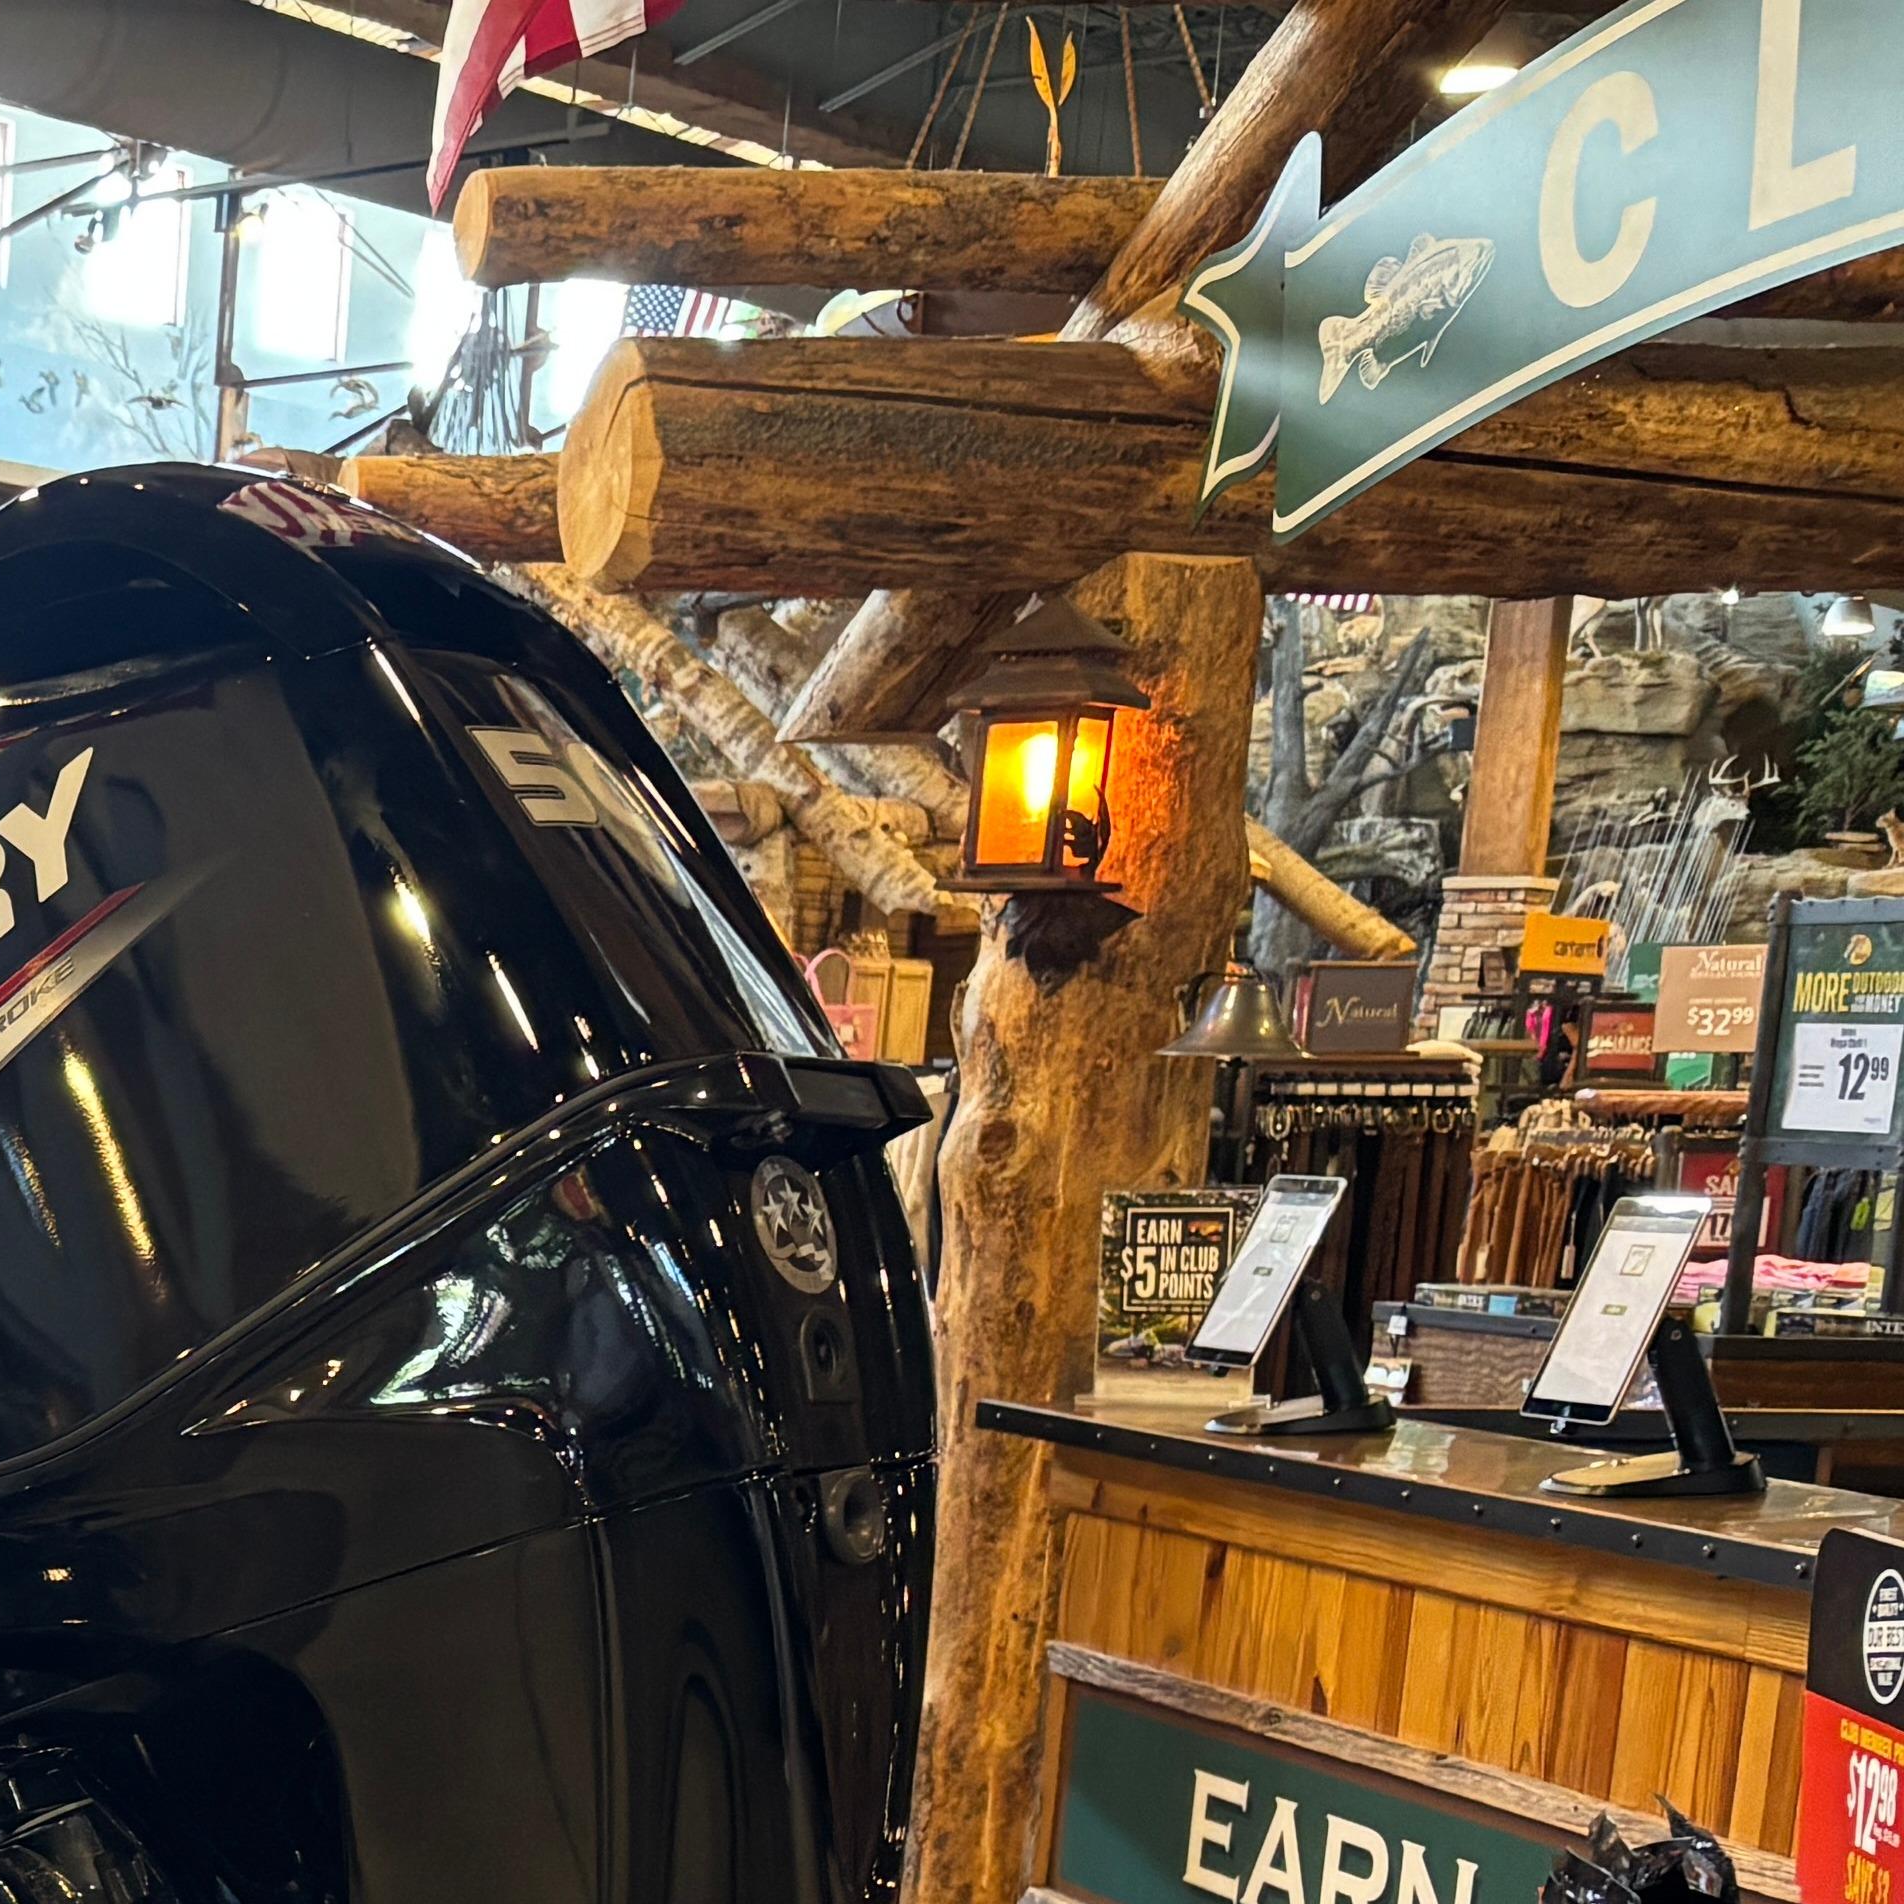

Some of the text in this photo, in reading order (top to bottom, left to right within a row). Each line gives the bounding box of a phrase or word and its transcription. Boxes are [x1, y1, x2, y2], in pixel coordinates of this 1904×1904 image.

[1694, 950, 1763, 972] Natural
[1793, 970, 1852, 1014] MORE
[1314, 996, 1398, 1028] Natural
[1136, 1218, 1183, 1244] EARN
[1120, 1245, 1220, 1299] $5 IN CLUB
[1158, 1272, 1215, 1299] POINTS
[1846, 1750, 1899, 1856] $1298
